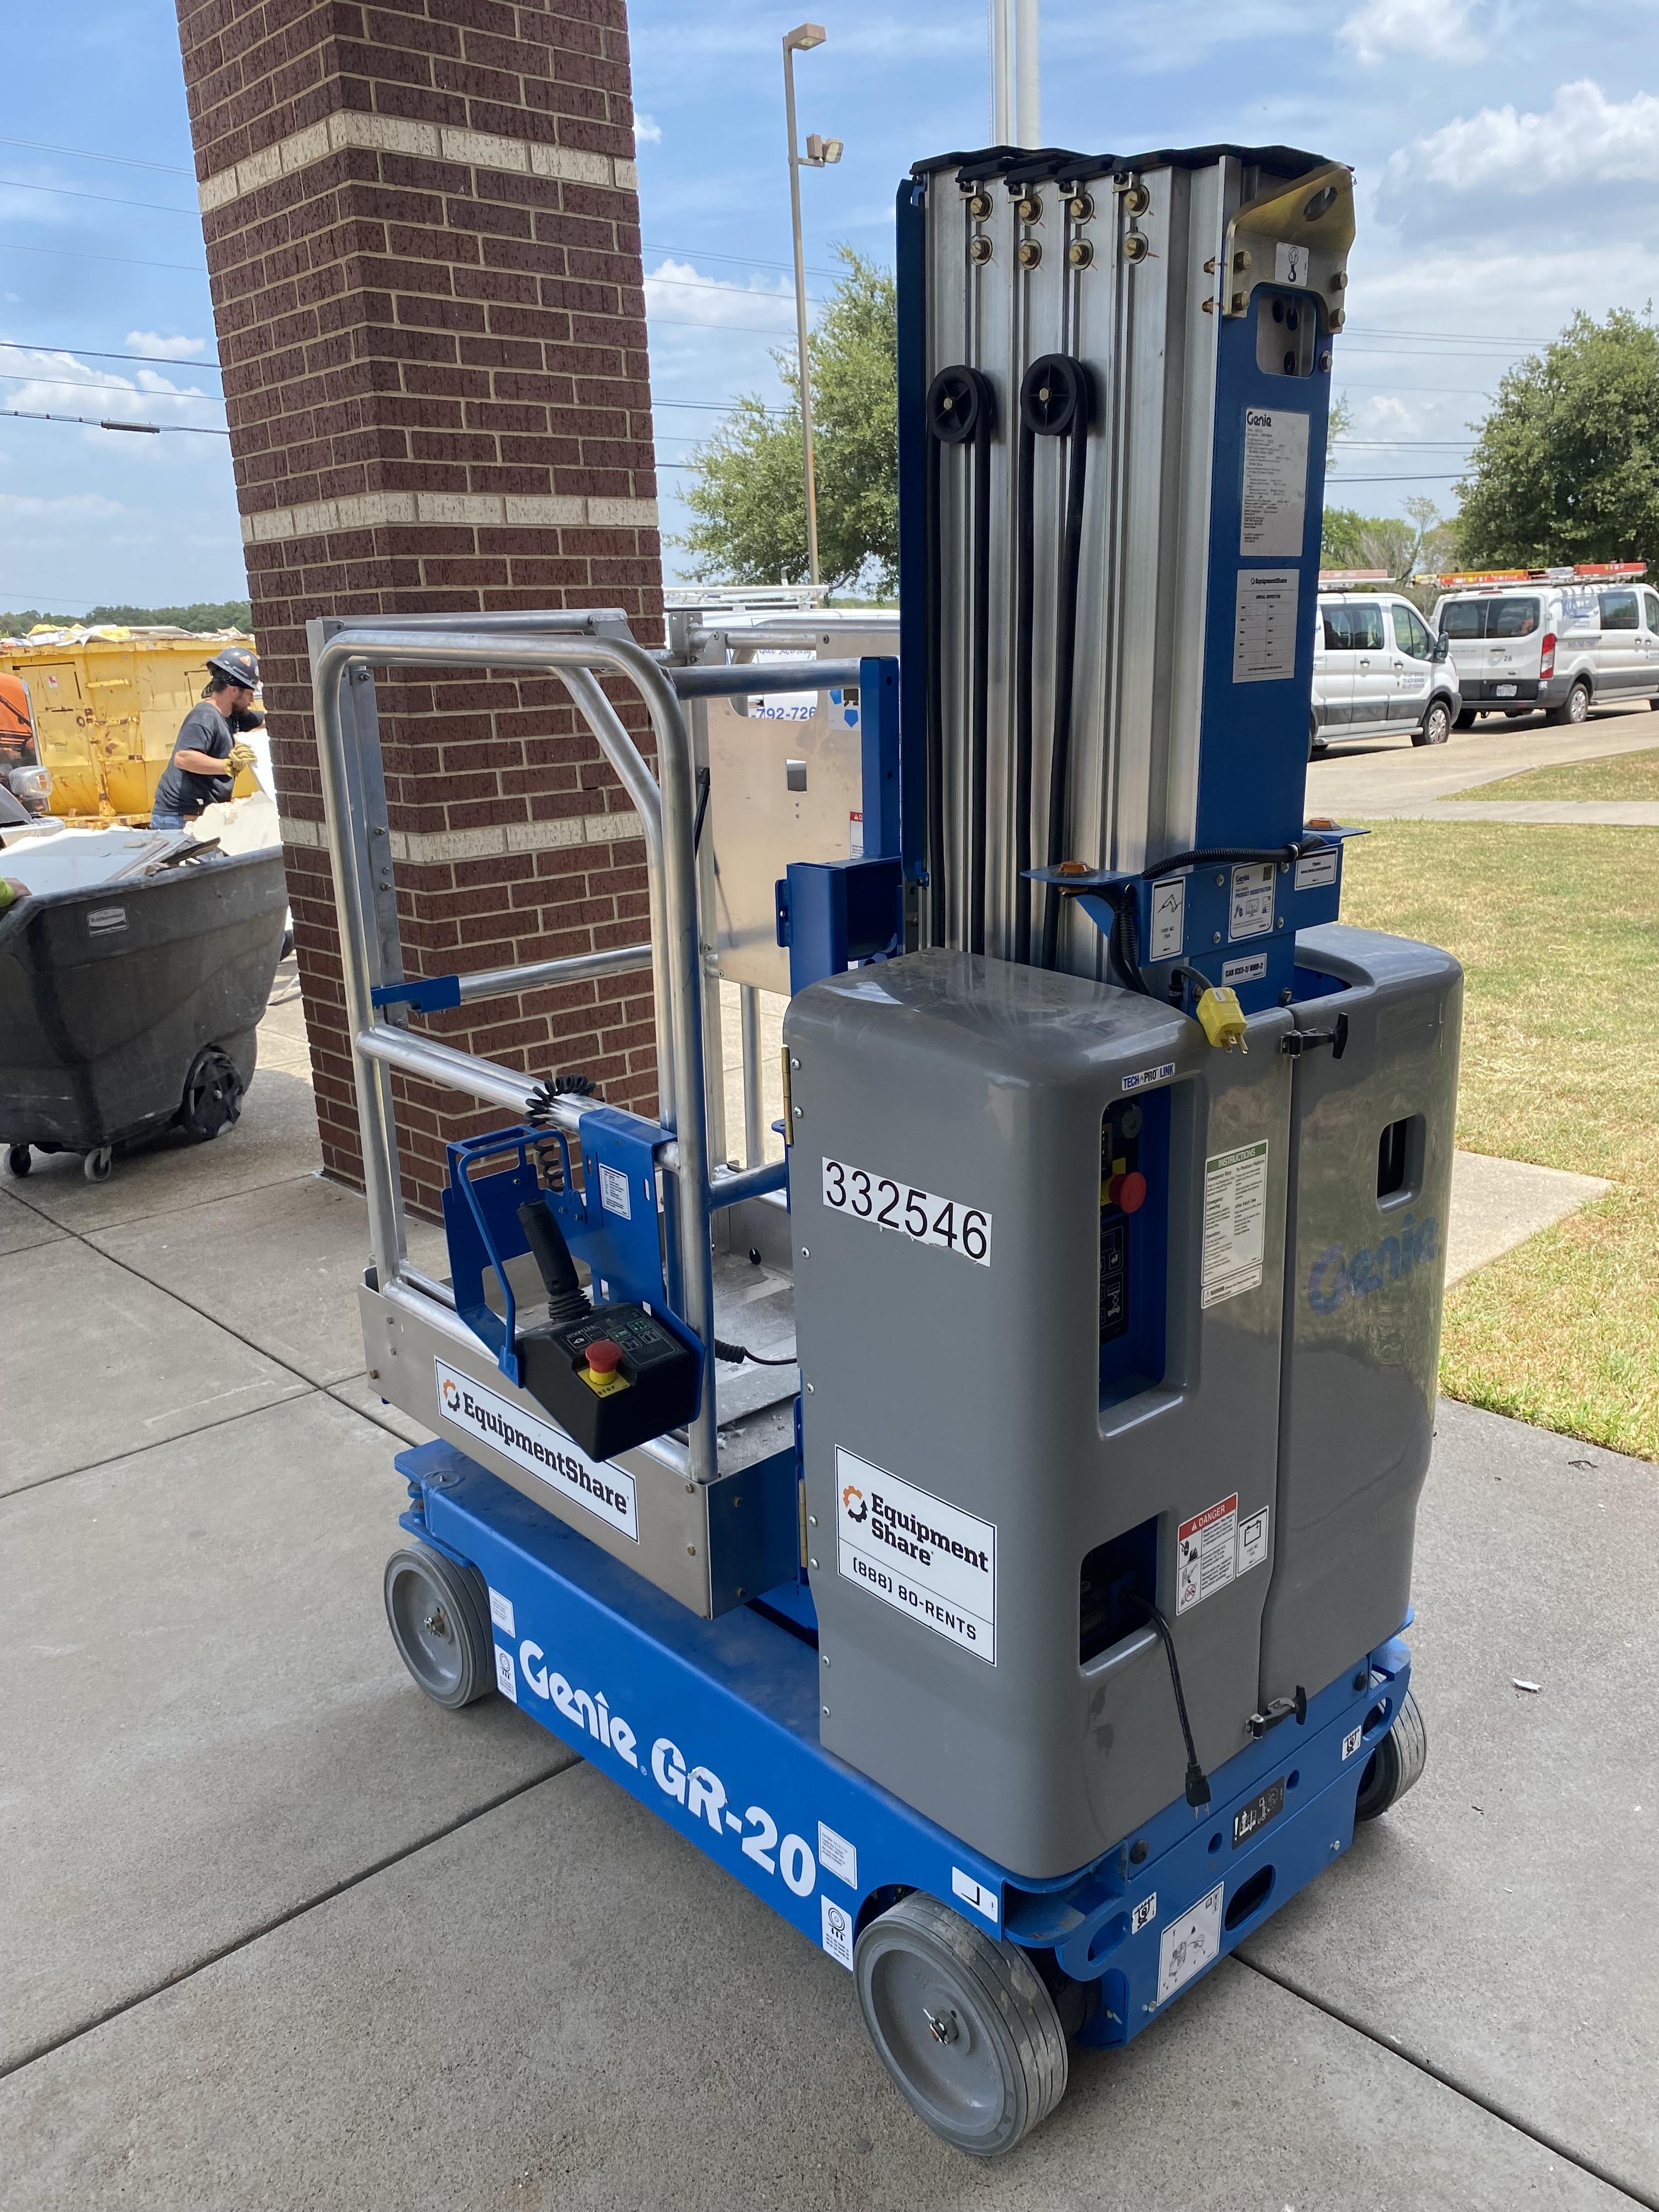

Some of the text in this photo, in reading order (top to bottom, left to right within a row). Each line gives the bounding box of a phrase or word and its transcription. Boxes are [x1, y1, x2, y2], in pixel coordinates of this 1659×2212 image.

[1247, 411, 1272, 427] Genie
[1235, 874, 1250, 883] Genie
[1123, 1075, 1139, 1089] TECH
[1160, 1064, 1174, 1078] LINK
[1218, 1148, 1256, 1168] INSTRUCTIONS
[826, 1161, 987, 1260] 332546
[1308, 1211, 1440, 1316] Genie
[597, 1385, 615, 1395] STOP
[462, 1392, 627, 1515] EquipmentShare
[871, 1492, 989, 1573] Equipment
[1199, 1504, 1225, 1527] DANGER
[872, 1517, 932, 1567] Share
[853, 1557, 976, 1641] (888) 80-RENTS
[519, 1639, 816, 1897] Genie GR-20
